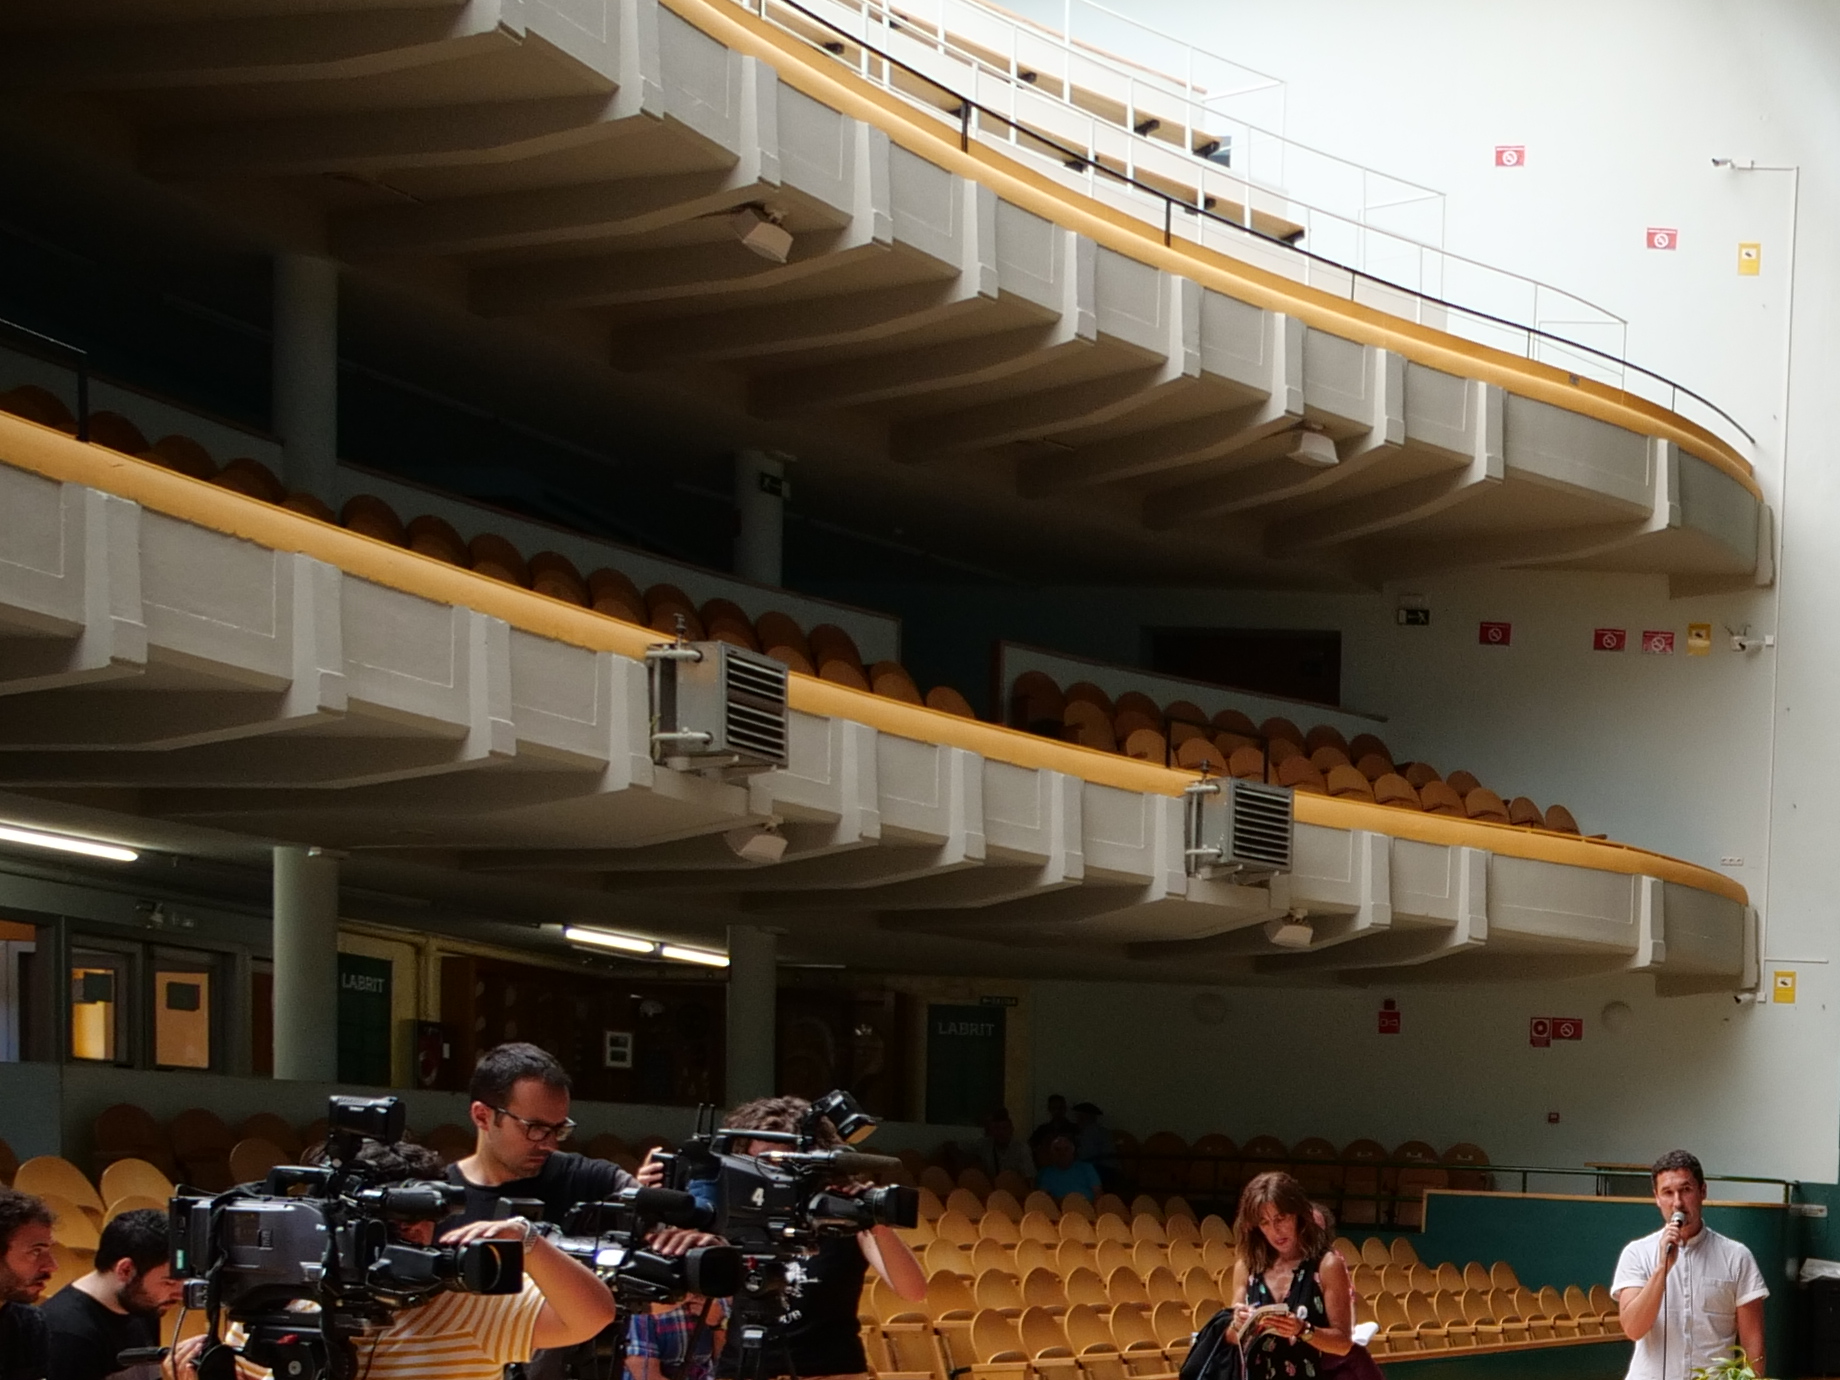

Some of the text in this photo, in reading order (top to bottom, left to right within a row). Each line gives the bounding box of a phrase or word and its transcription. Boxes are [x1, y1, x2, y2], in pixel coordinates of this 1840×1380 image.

[341, 973, 385, 994] LABRIT
[937, 1021, 995, 1037] LABRIT
[752, 1187, 765, 1207] 4
